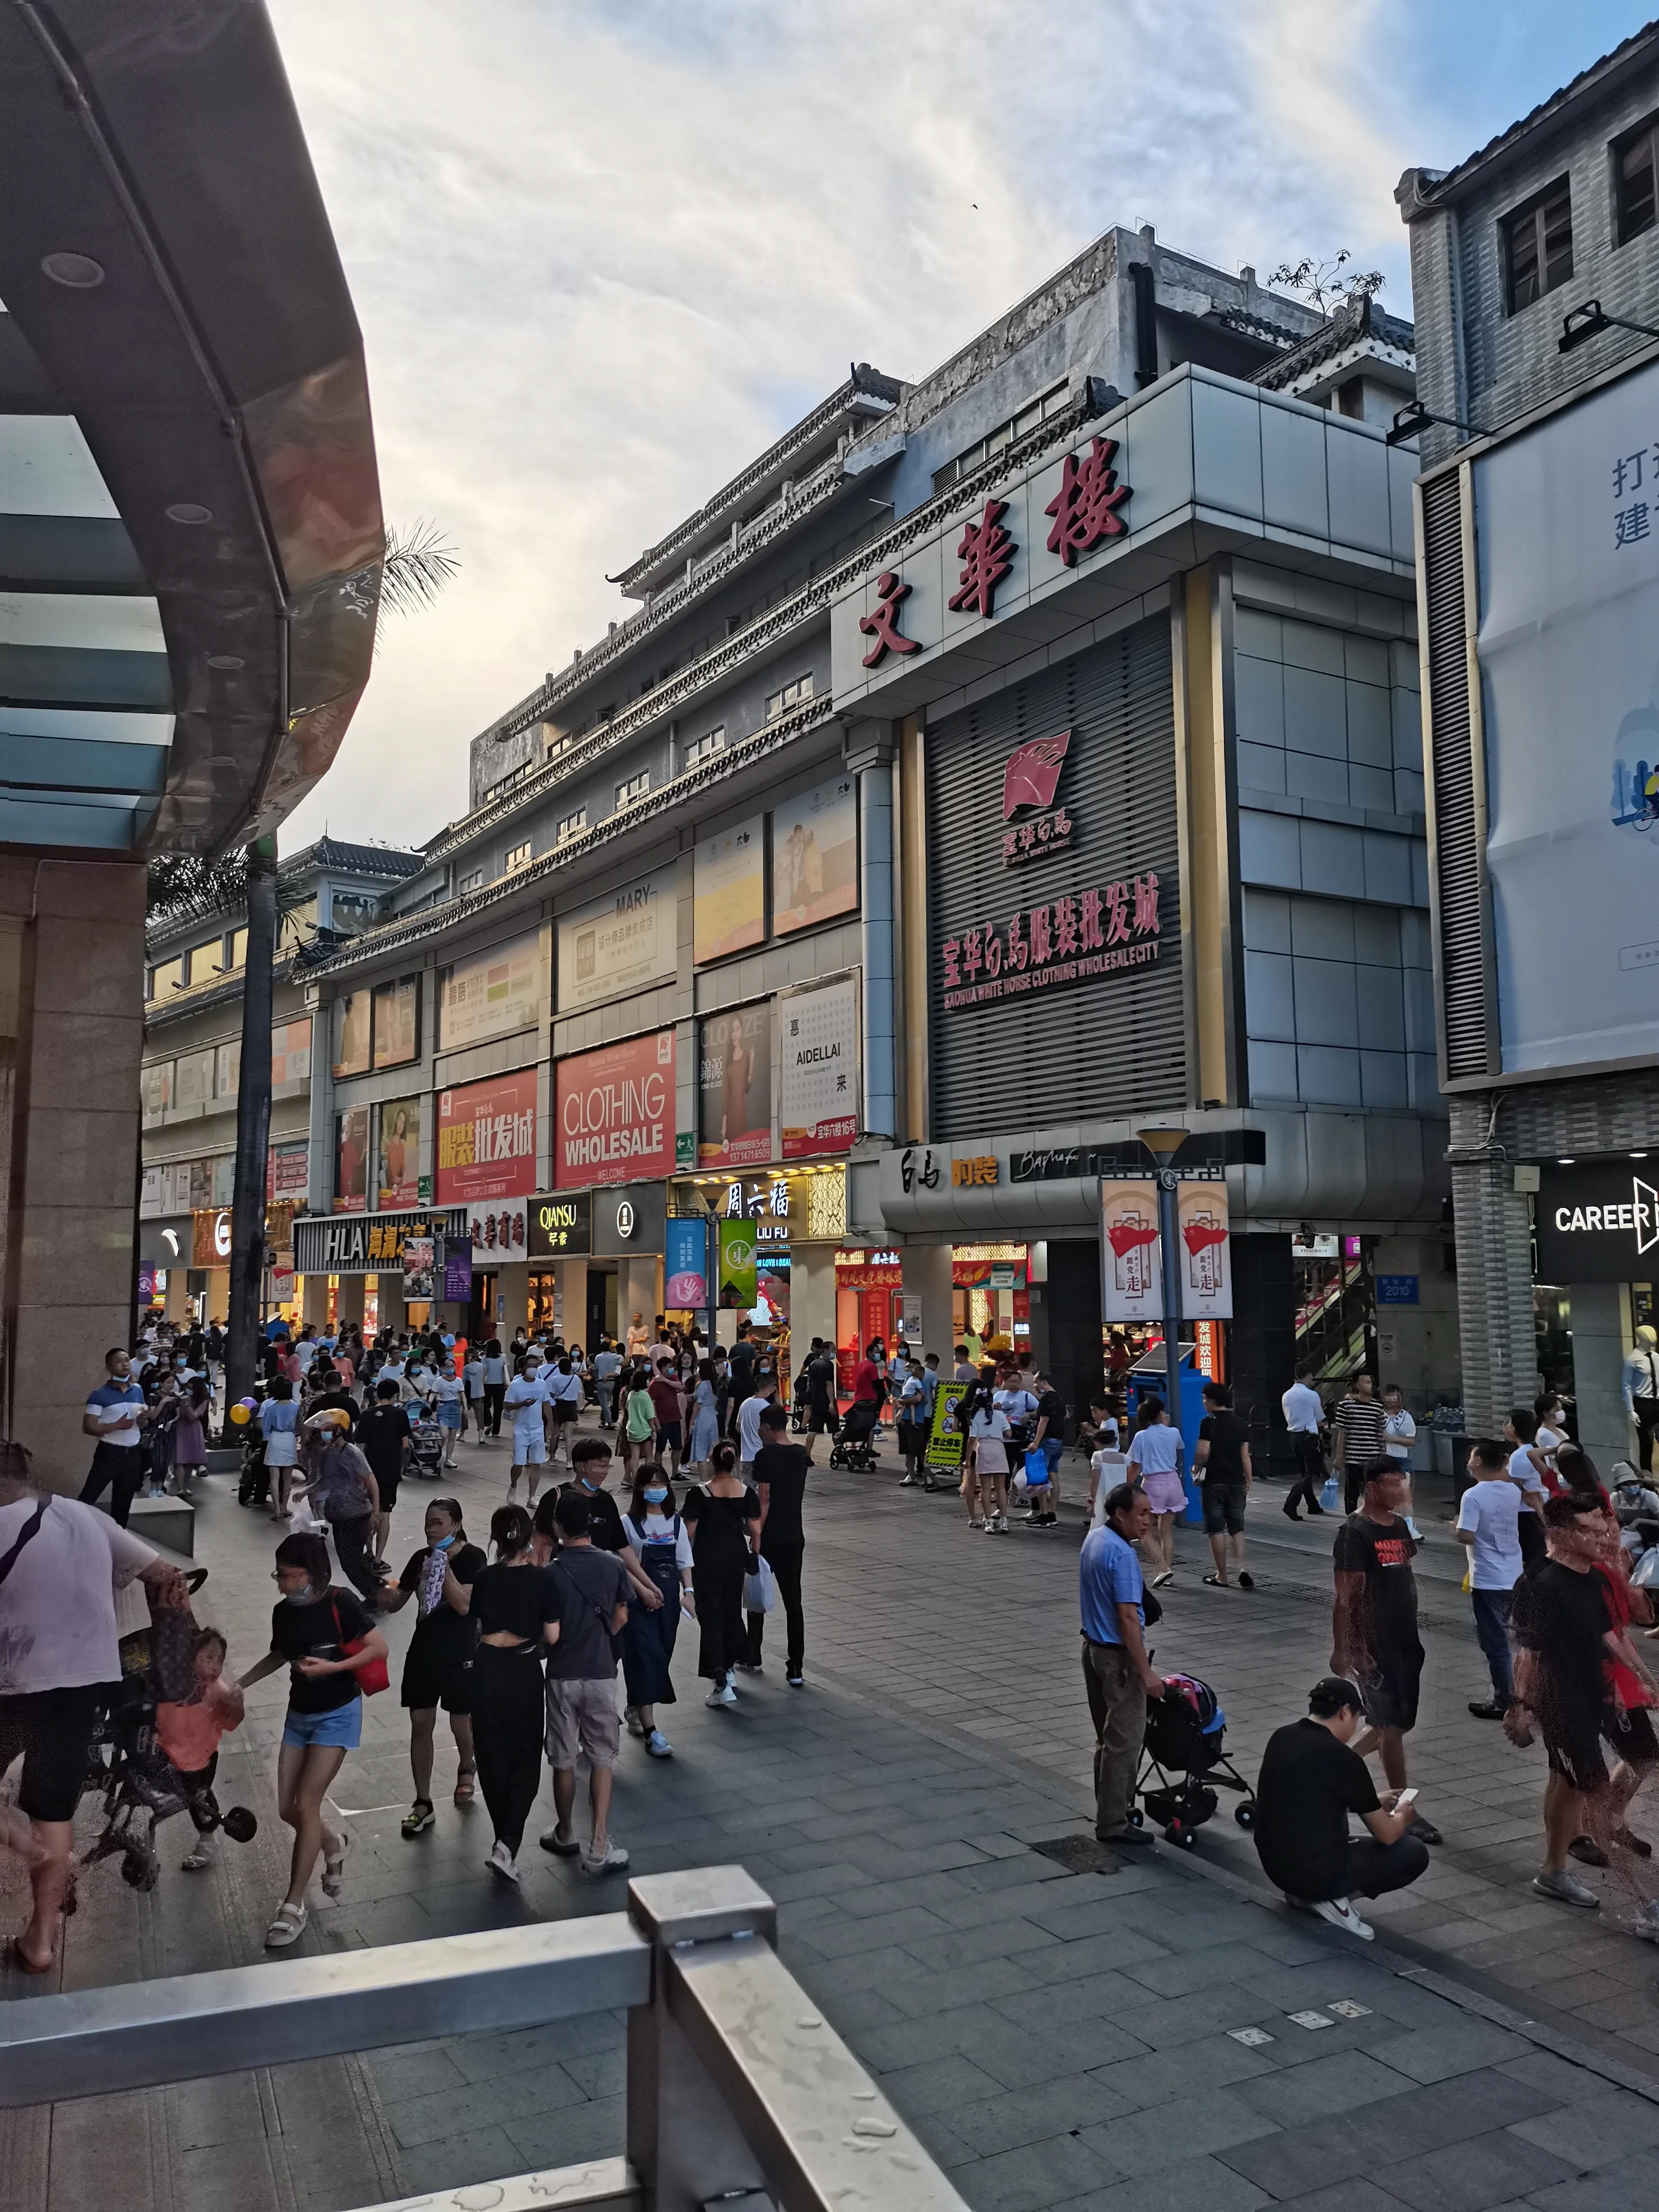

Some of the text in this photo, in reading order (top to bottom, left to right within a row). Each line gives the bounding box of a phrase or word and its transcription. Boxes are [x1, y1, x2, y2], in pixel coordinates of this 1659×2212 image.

[616, 884, 650, 918] MARY
[944, 987, 977, 1009] BAOHUA
[977, 981, 1003, 1001] WHITE
[1004, 973, 1031, 995] HORSE
[1032, 961, 1076, 987] CLOTHING
[796, 1041, 841, 1066] AIDELLAI
[837, 1073, 847, 1093] 来
[564, 1072, 665, 1136] CLOTHING
[439, 1108, 533, 1169] 服装批发城
[817, 1118, 856, 1139] 宝华六楼16号
[565, 1123, 663, 1166] WHOLESALE
[597, 1166, 625, 1181] WELCOME
[726, 1178, 790, 1219] 周六福
[540, 1204, 577, 1230] QIANSU
[757, 1226, 788, 1239] LIU FU
[1555, 1203, 1650, 1231] CAREER
[325, 1227, 364, 1261] HLA
[1127, 1256, 1140, 1293] 跟党走
[1200, 1255, 1213, 1290] 跟党走
[1385, 1286, 1410, 1296] 2010
[933, 1437, 962, 1447] 禁止停车
